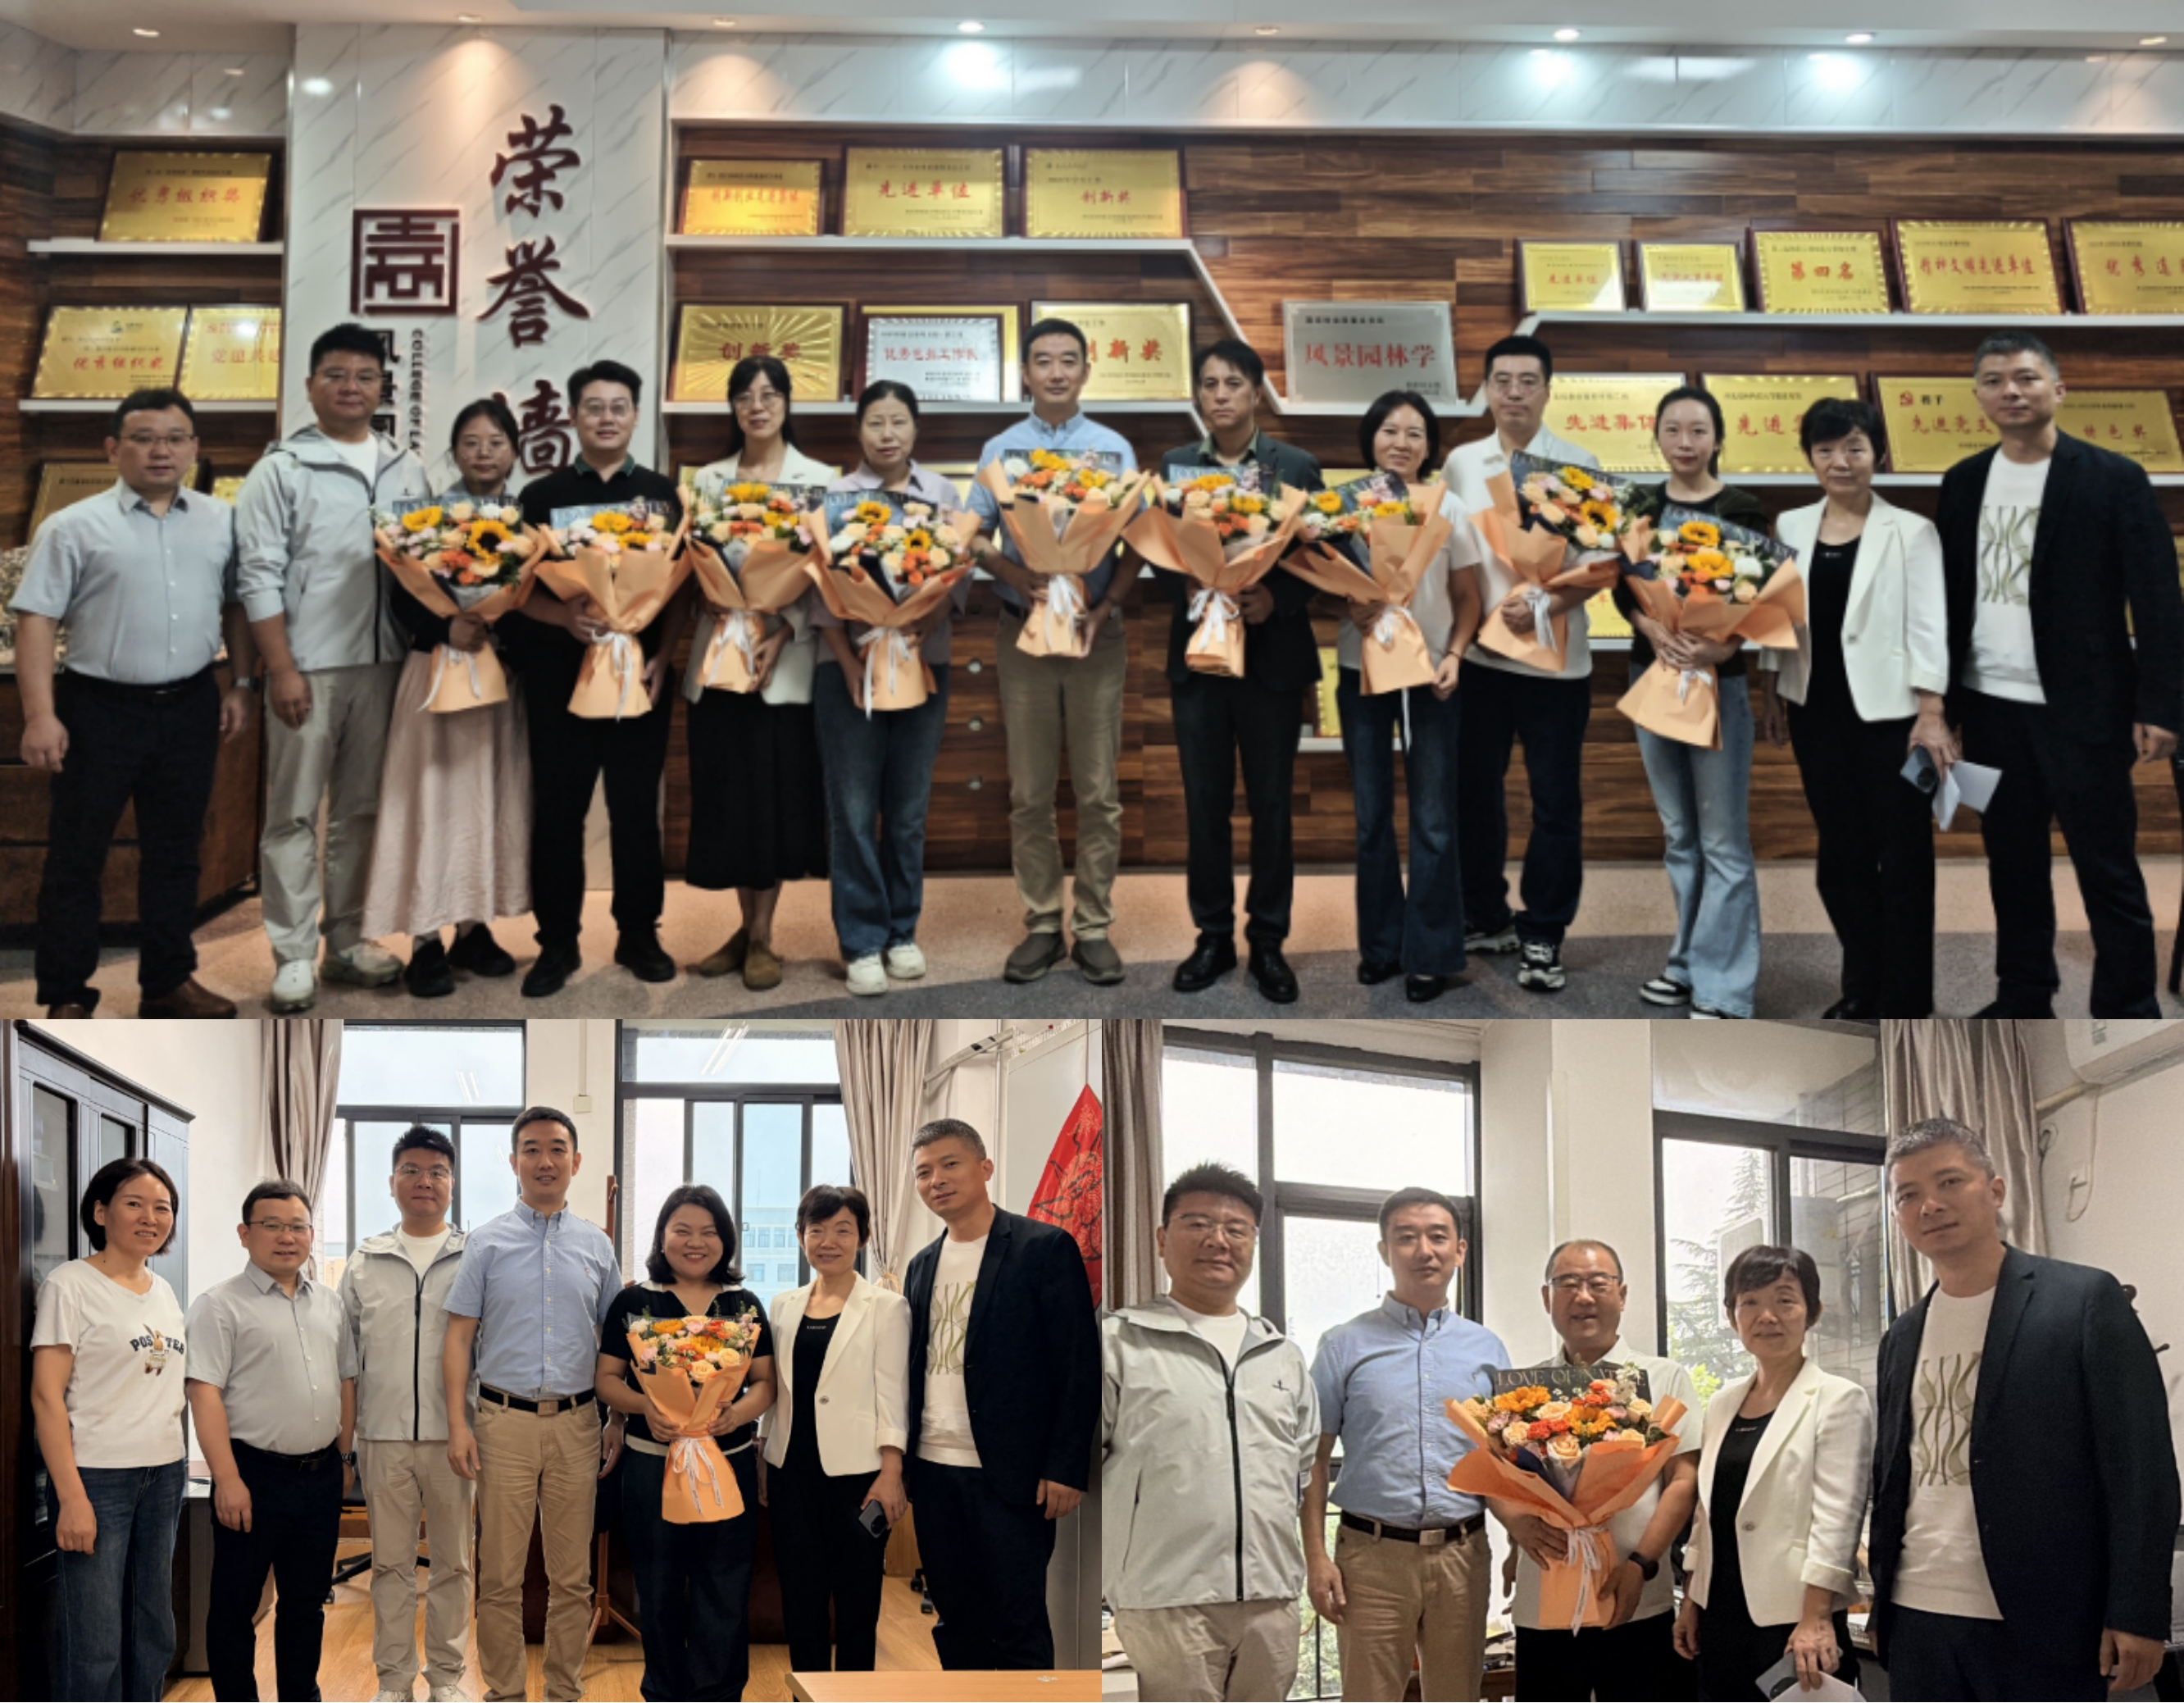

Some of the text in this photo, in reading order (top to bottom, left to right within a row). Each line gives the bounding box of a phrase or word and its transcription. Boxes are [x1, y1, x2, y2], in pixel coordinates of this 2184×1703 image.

[878, 179, 971, 199] 先进单位
[1790, 260, 1854, 281] 第四名
[476, 103, 590, 476] 荣誉墙
[717, 341, 803, 362] 创新奖
[1305, 342, 1438, 369] 风景园林学
[1496, 1370, 1545, 1387] LOVE
[1580, 1367, 1646, 1387] NATE
